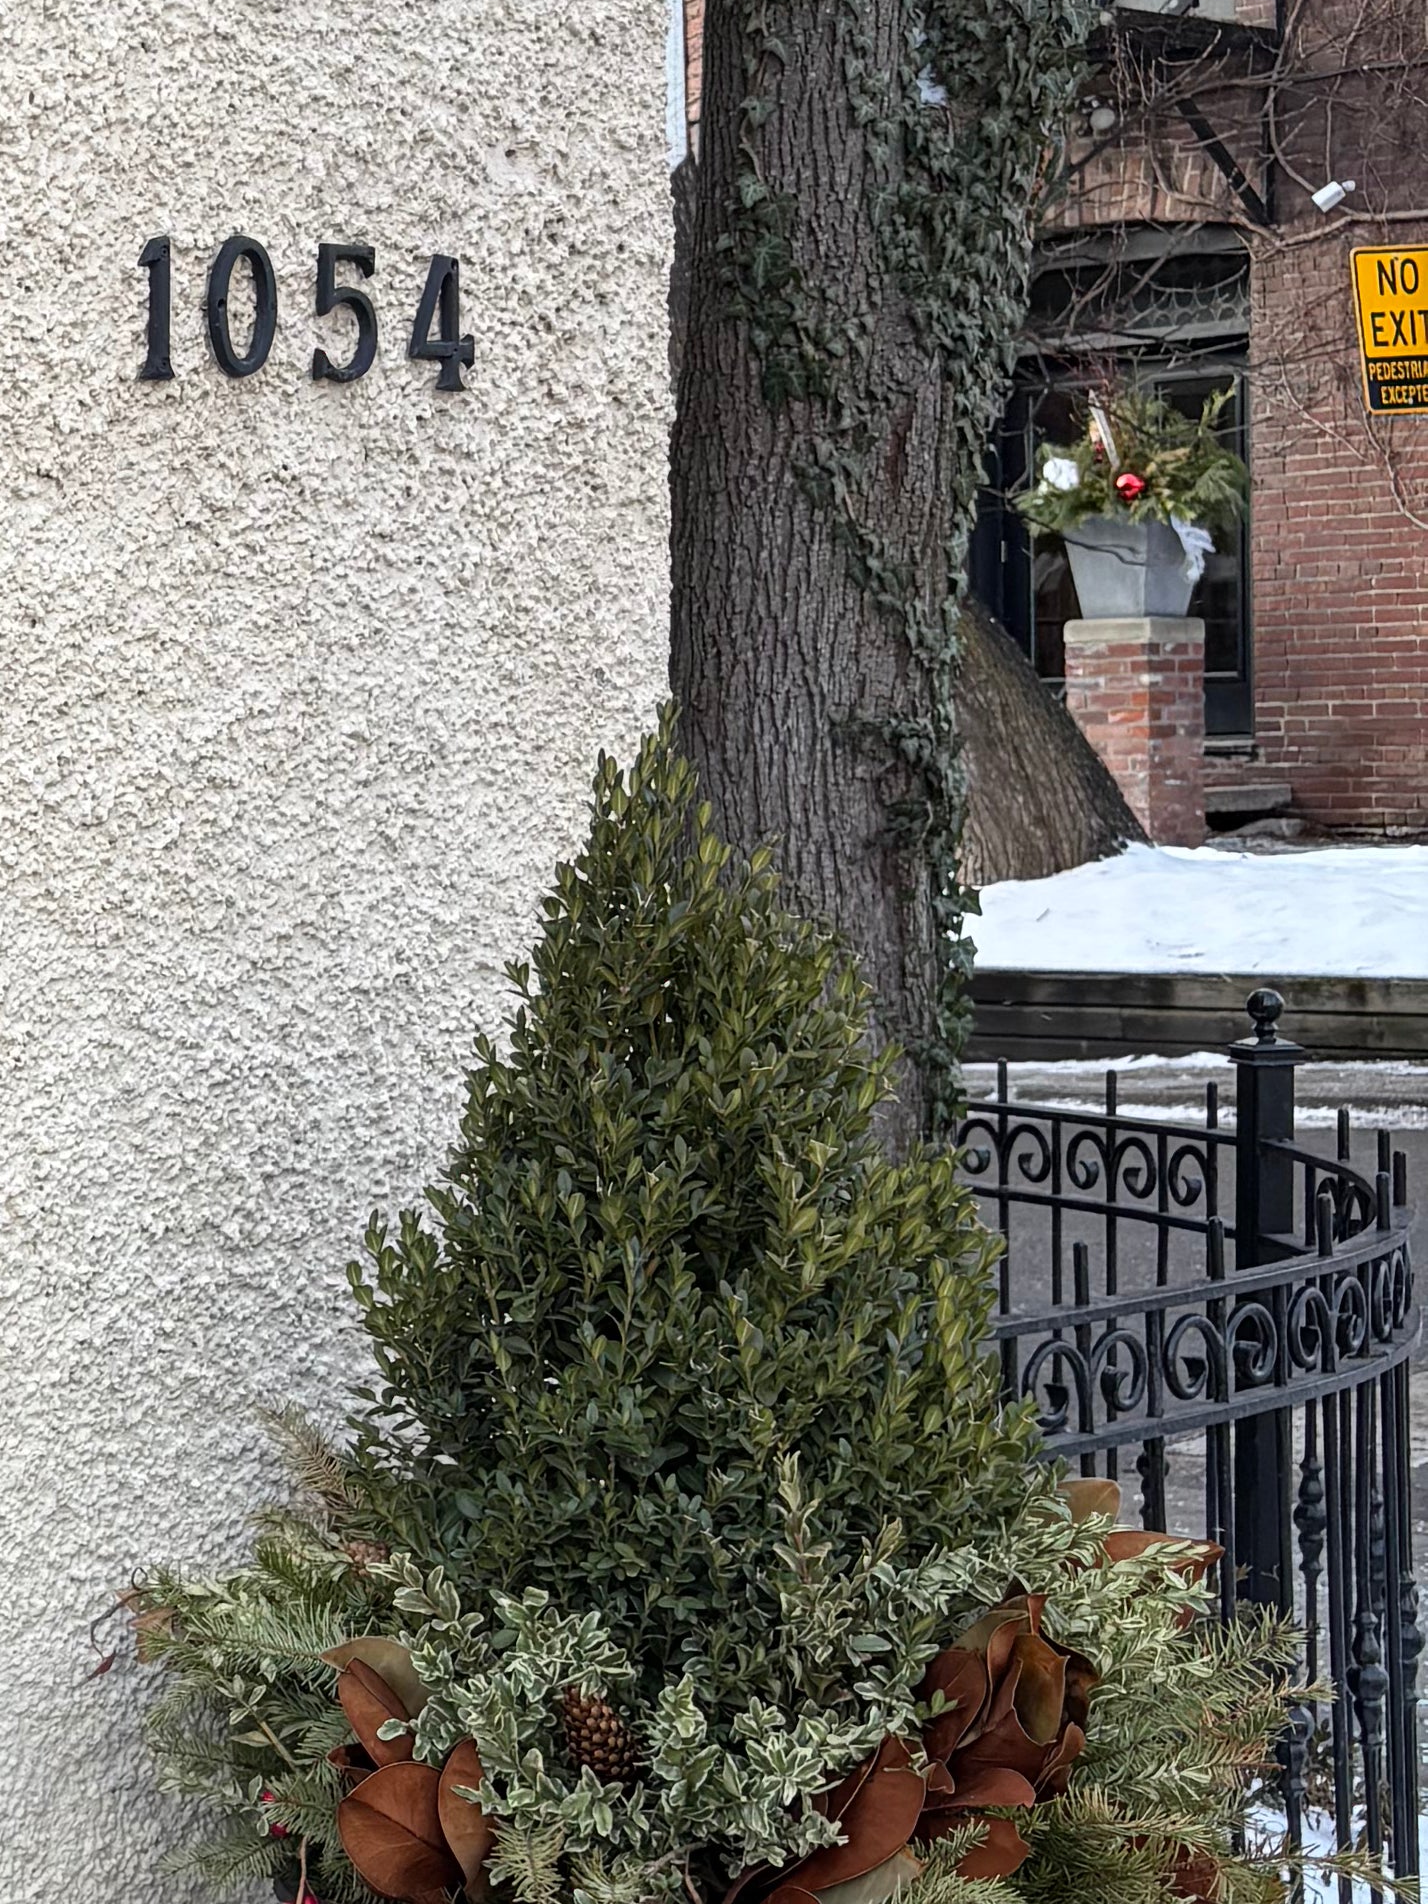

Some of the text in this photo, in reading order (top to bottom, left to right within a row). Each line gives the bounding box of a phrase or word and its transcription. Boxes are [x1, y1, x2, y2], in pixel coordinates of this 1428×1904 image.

[1377, 257, 1419, 296] NO
[138, 235, 475, 392] 1054
[1370, 309, 1428, 348] EXIT
